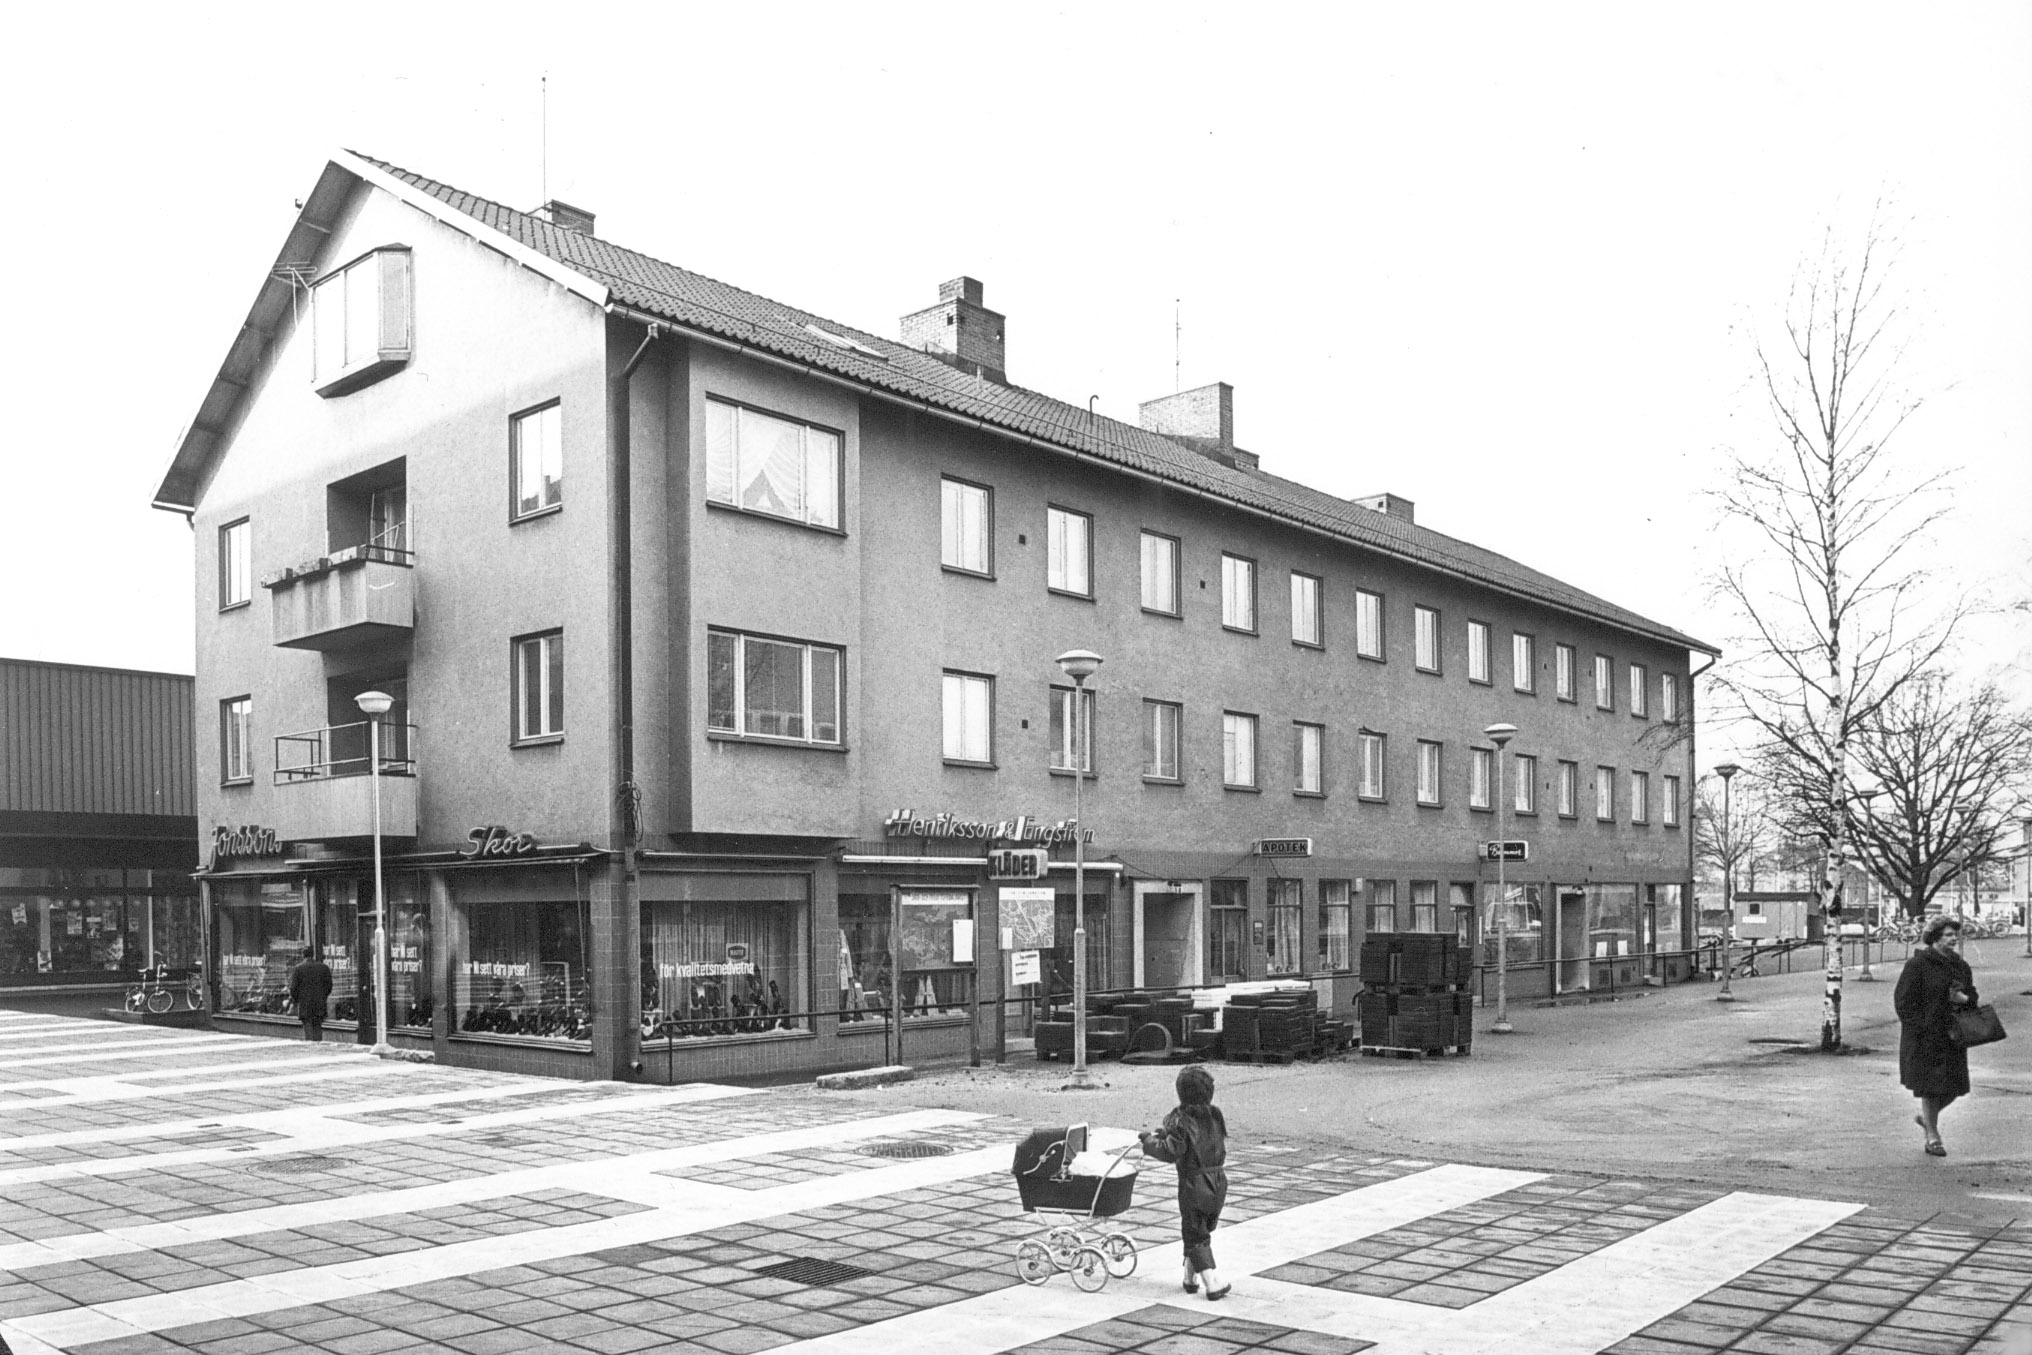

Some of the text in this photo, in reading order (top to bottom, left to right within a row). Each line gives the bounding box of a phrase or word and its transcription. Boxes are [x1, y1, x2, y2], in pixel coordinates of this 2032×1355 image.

[885, 809, 996, 839] Henriksson
[1004, 822, 1015, 840] &
[459, 826, 532, 856] Skor
[1262, 842, 1307, 852] APOTEK
[989, 851, 1038, 876] KLÄDER
[660, 959, 754, 978] för kvalitetsmedvetna
